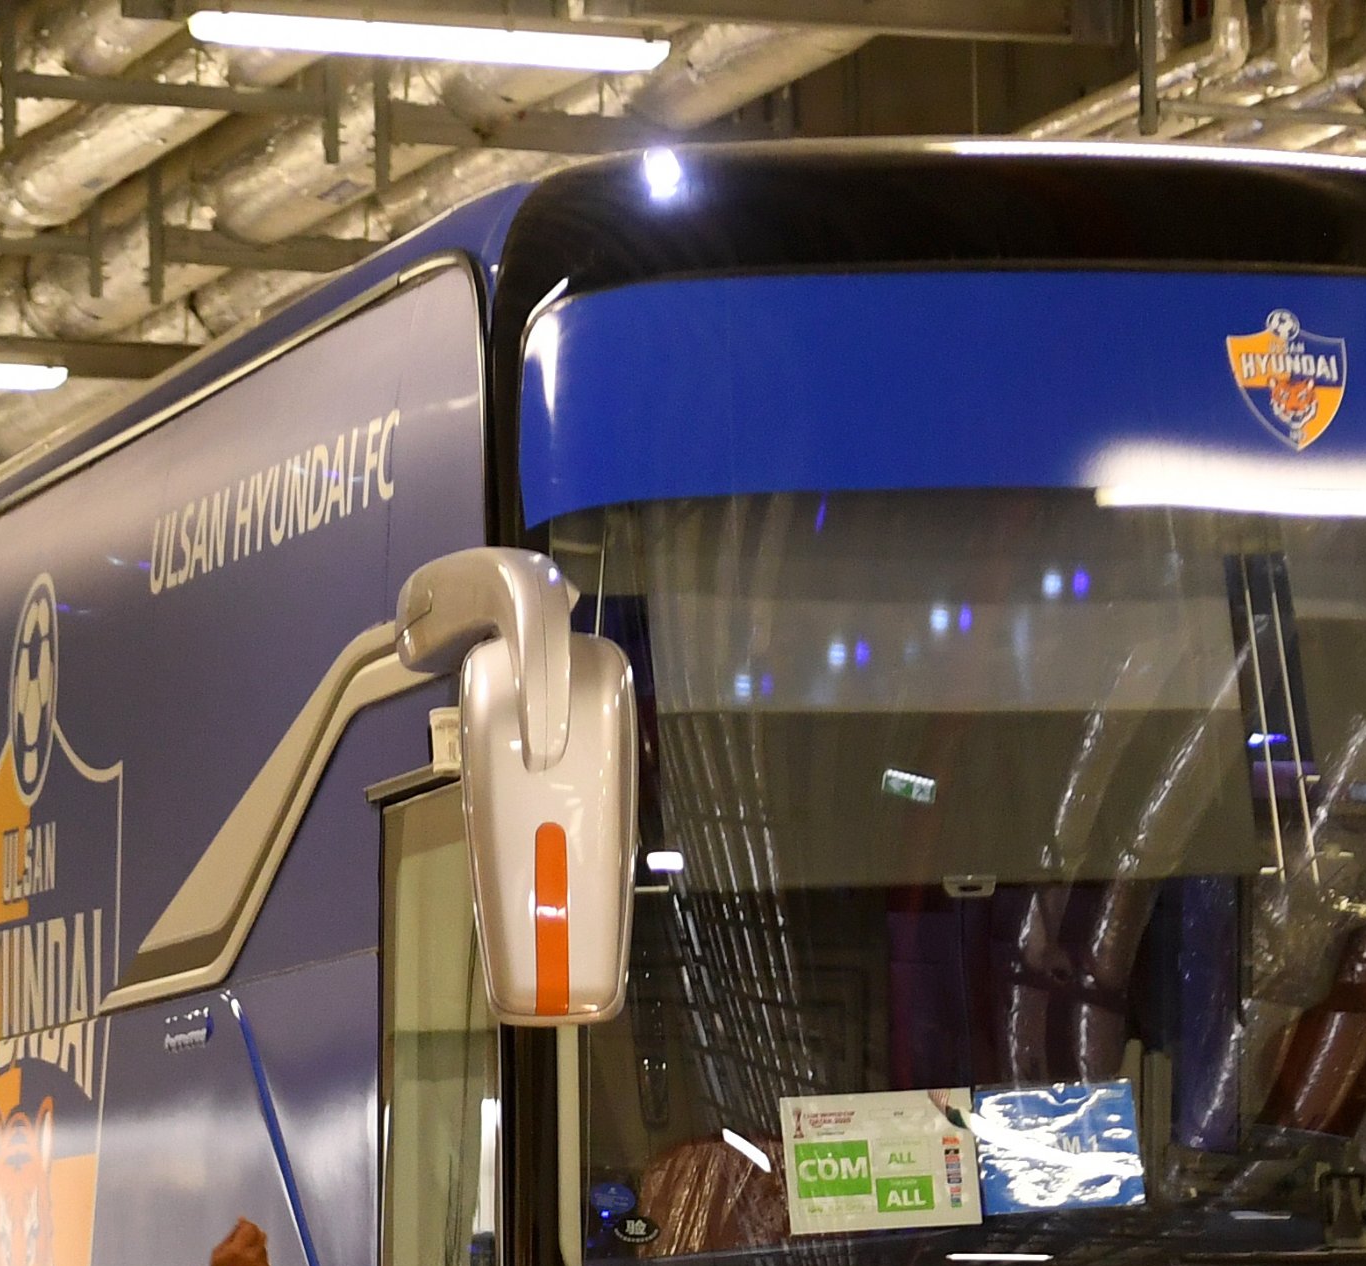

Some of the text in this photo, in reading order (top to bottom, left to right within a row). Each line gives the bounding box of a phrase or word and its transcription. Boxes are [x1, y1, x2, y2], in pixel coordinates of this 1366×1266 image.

[1241, 352, 1338, 381] HYUNDAI
[150, 408, 400, 595] ULSAN HYUNDAI FC
[3, 821, 56, 905] ULSAN
[798, 1156, 869, 1183] COM
[888, 1152, 916, 1165] ALL
[886, 1188, 927, 1208] ALL
